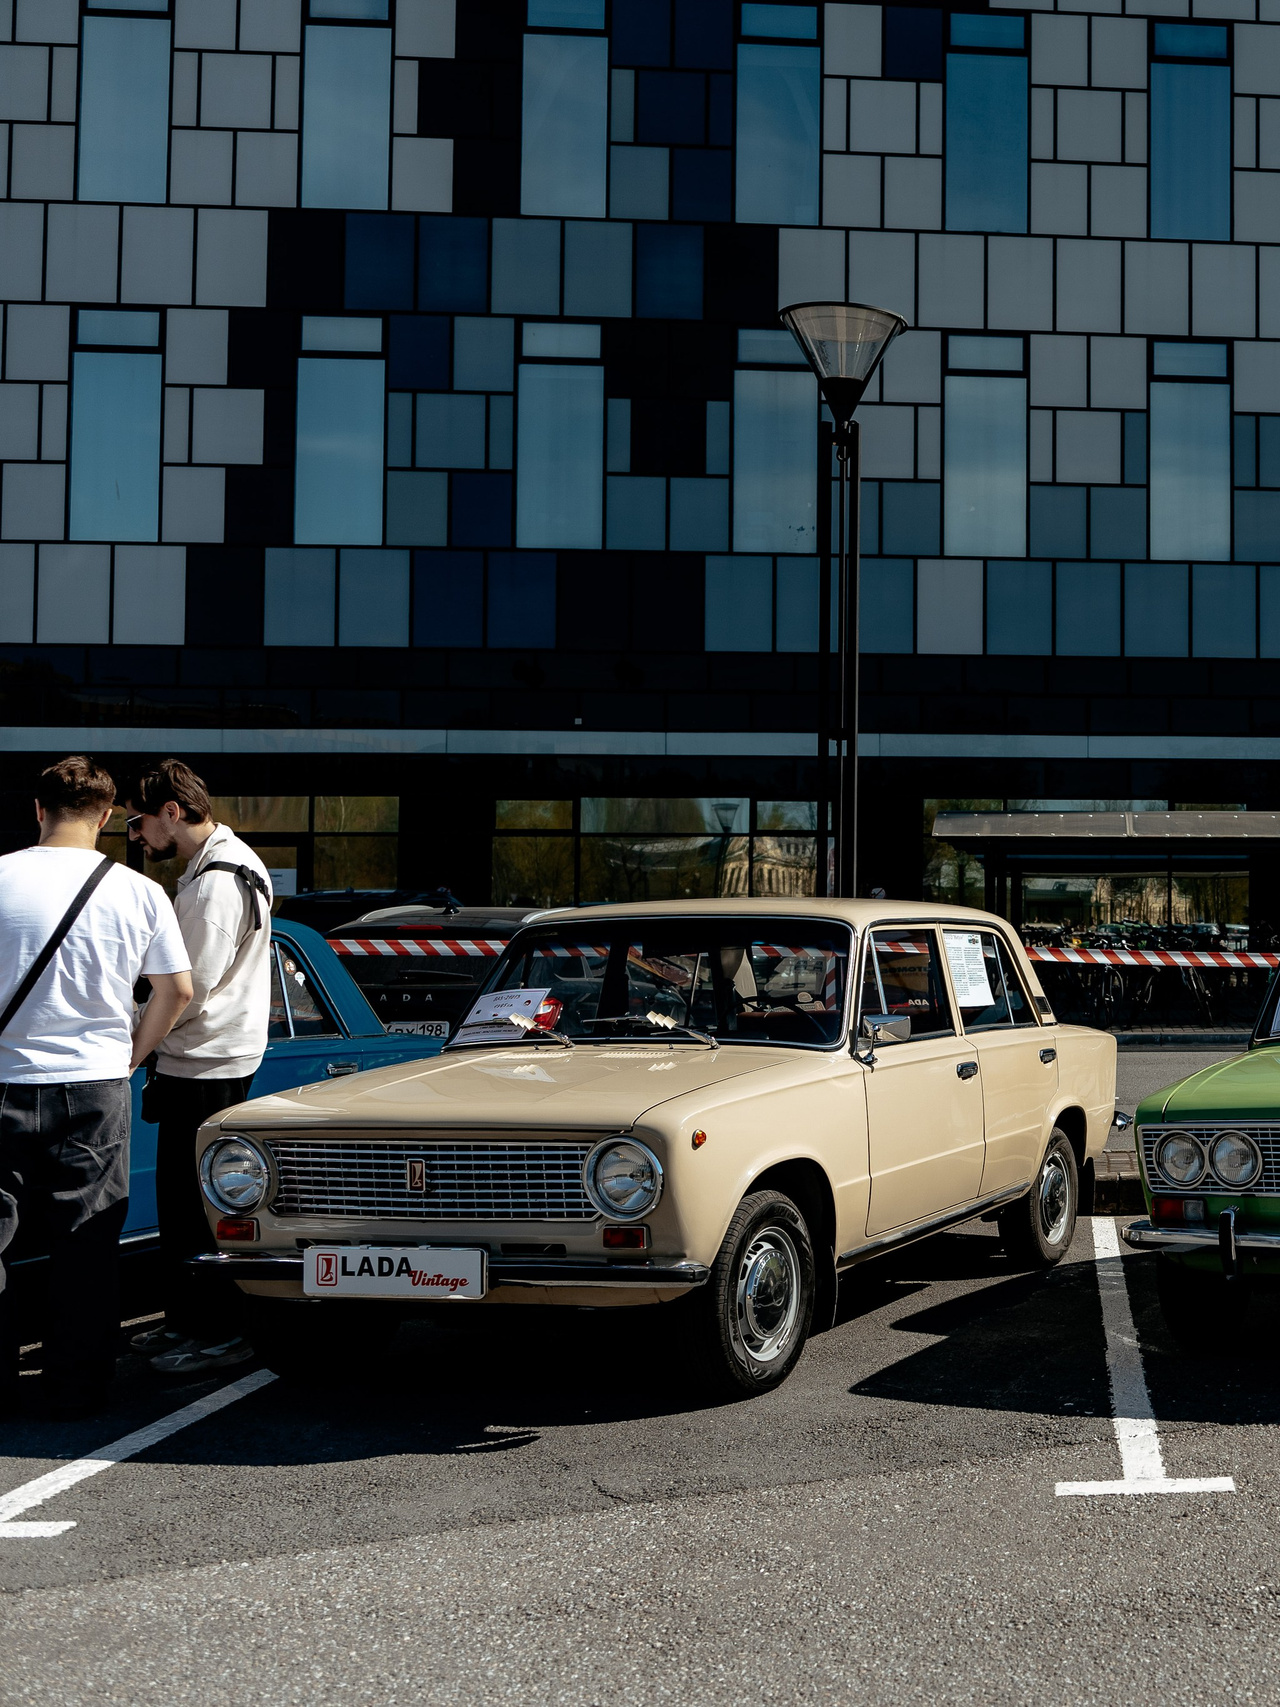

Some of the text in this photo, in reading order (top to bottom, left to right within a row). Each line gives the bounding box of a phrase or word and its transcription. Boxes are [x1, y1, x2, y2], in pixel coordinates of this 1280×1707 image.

[380, 993, 433, 1002] ADA
[418, 1024, 443, 1037] 198
[341, 1255, 469, 1292] LADA Vintage
